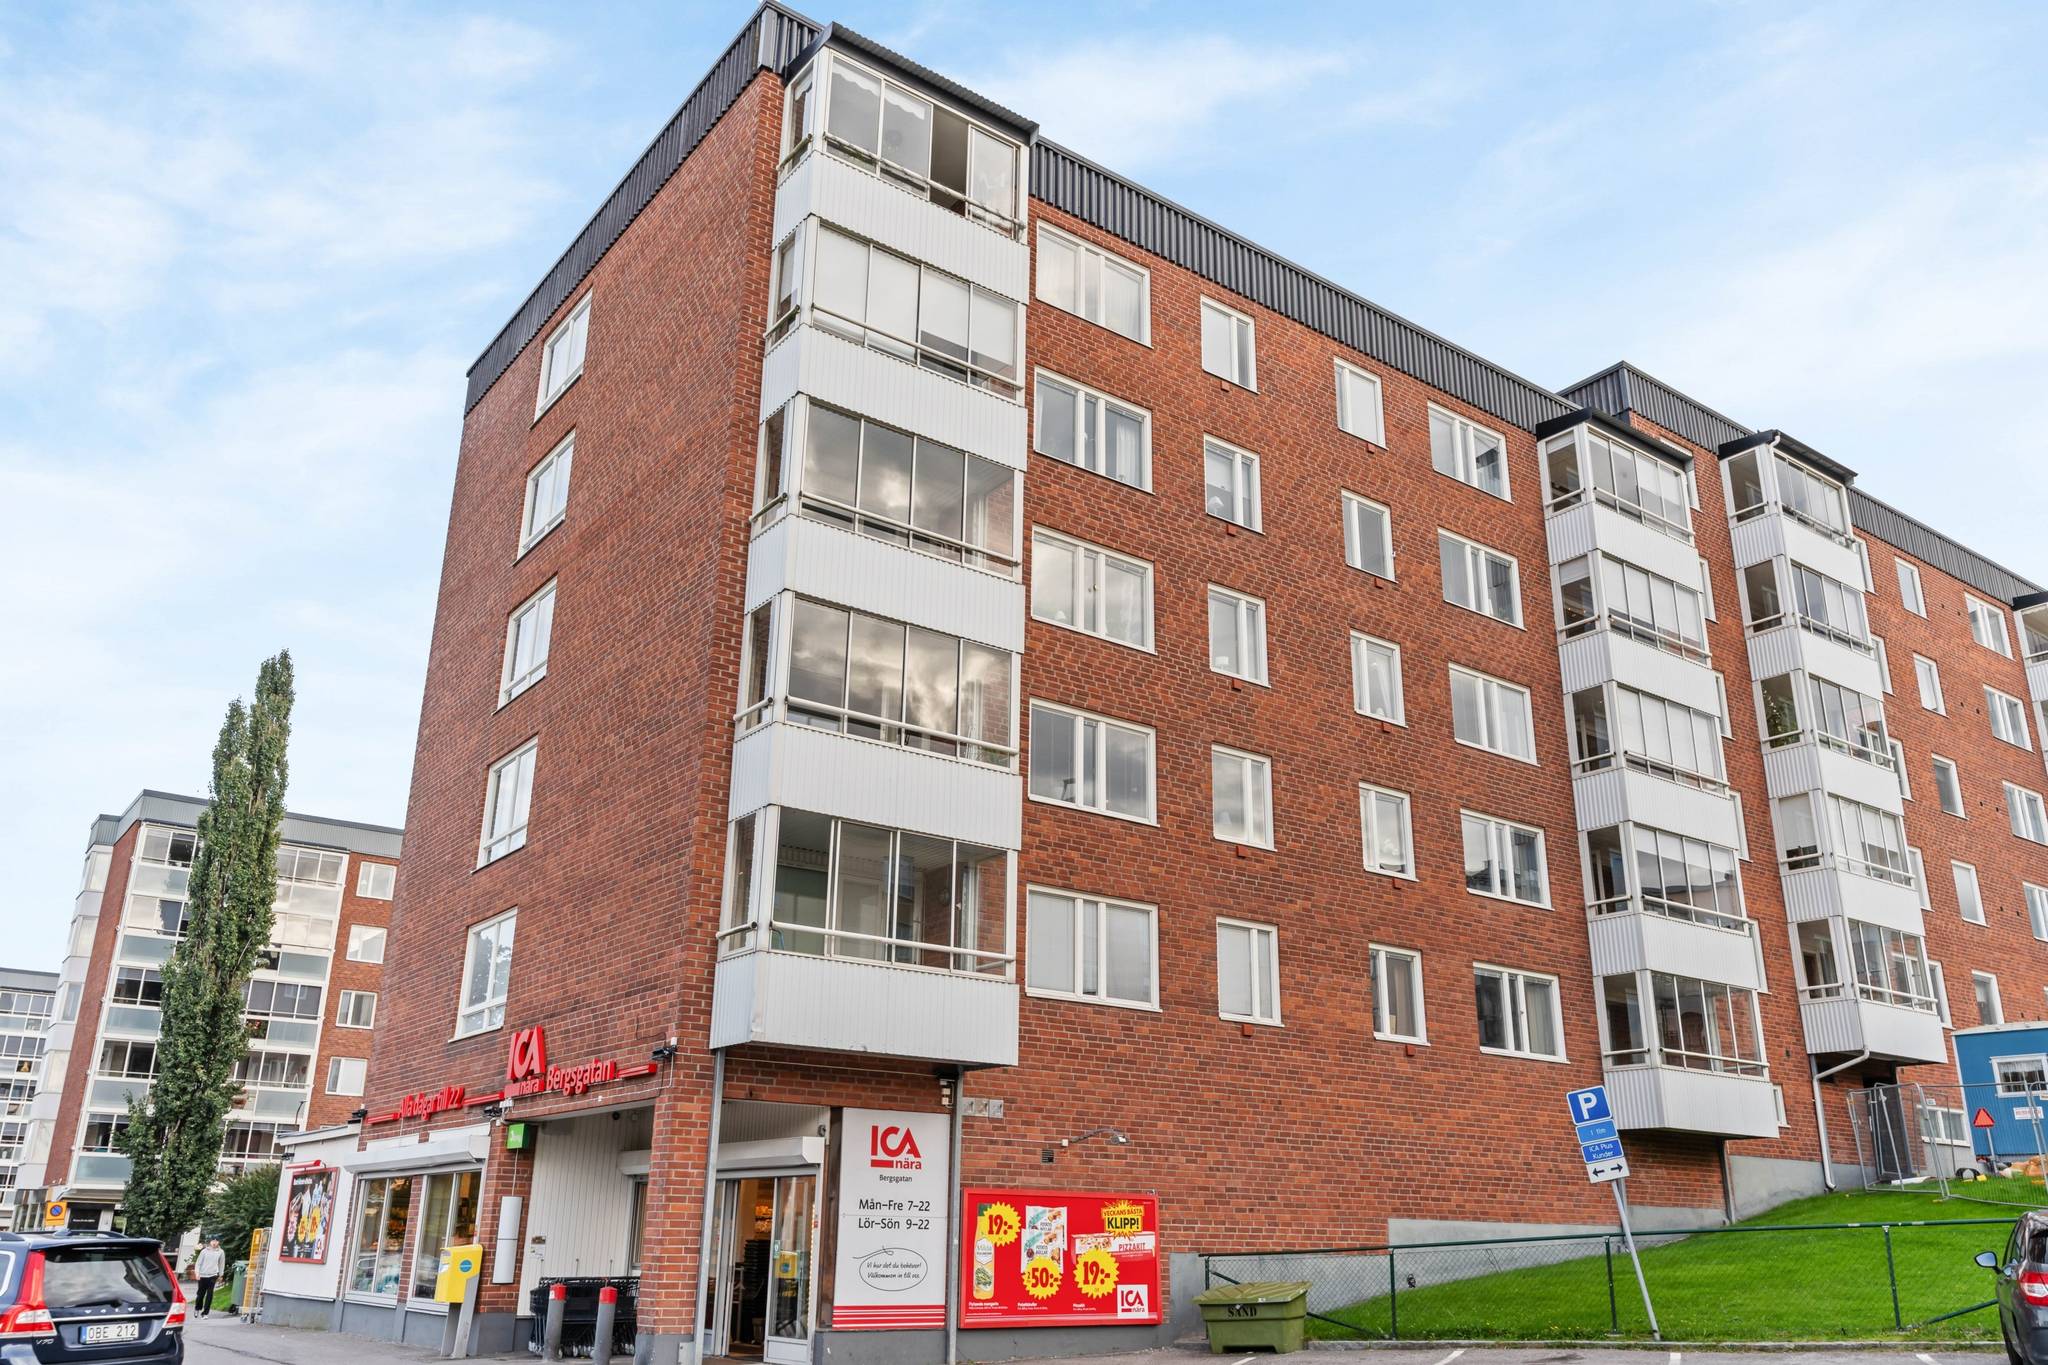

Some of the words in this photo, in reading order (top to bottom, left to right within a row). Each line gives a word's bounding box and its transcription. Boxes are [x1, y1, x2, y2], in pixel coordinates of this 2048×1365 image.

[506, 1024, 546, 1080] ICA
[546, 1058, 615, 1096] Bergsgatan
[1578, 1092, 1598, 1120] P
[870, 1125, 922, 1158] ICA
[1592, 1151, 1614, 1159] Kunder
[895, 1158, 922, 1170] nära
[879, 1174, 913, 1184] Bergsgatan
[907, 1200, 931, 1212] 7-22
[1127, 1207, 1143, 1215] BÄSTA
[906, 1218, 930, 1230] 9-22
[988, 1214, 1013, 1235] 19:-
[1107, 1217, 1139, 1229] KLIPP!
[1118, 1243, 1146, 1252] PIZZAKIT
[1031, 1267, 1059, 1288] 50:-
[1083, 1261, 1111, 1285] 19:-
[1121, 1289, 1144, 1307] ICA
[1228, 1306, 1257, 1318] SAND
[116, 1324, 136, 1337] 212
